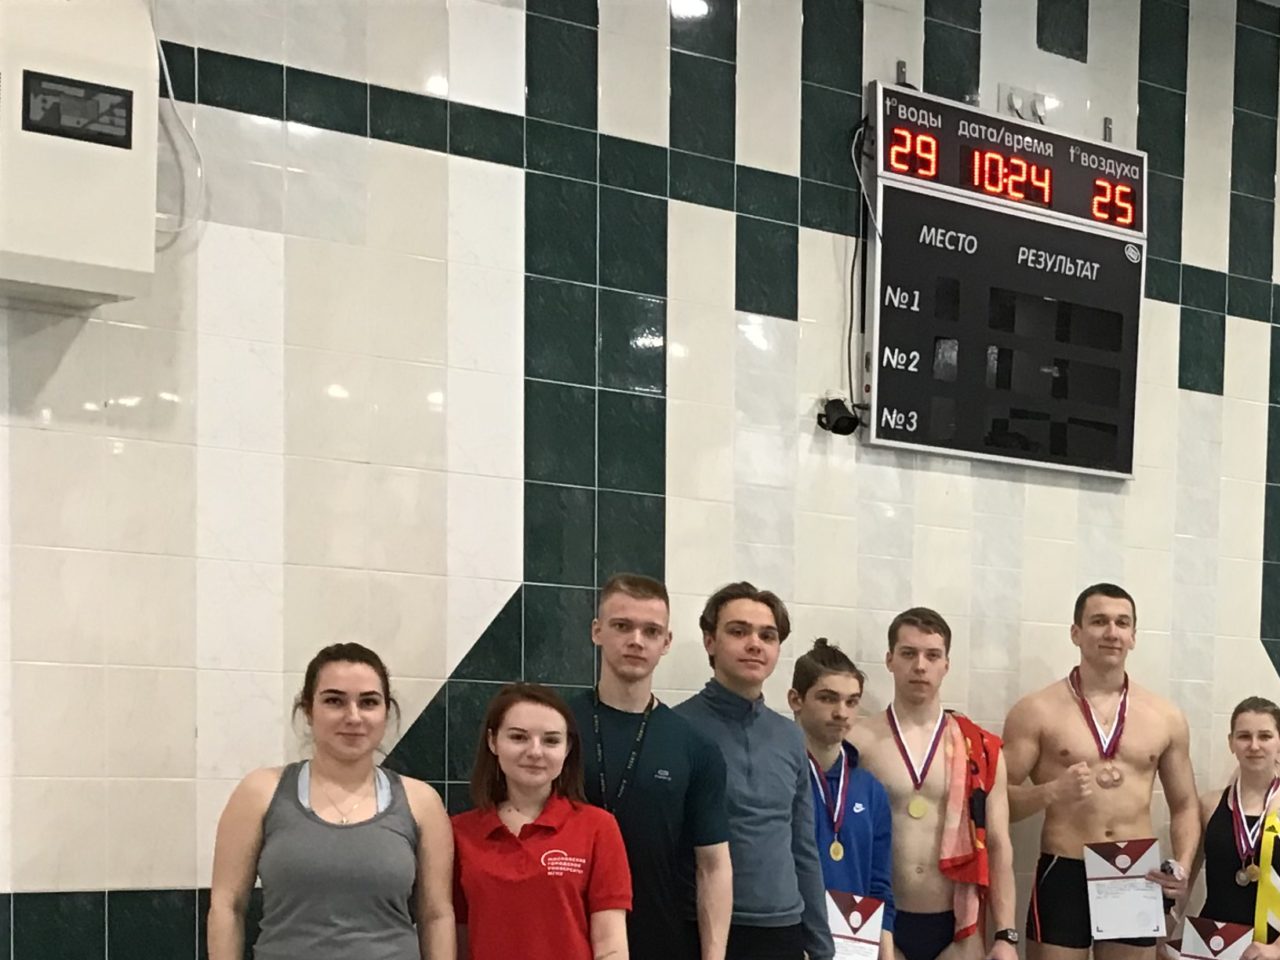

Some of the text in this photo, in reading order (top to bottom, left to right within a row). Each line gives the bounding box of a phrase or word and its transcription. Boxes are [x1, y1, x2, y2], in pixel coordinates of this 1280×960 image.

[890, 127, 936, 176] 29
[958, 120, 1053, 157] дата/время
[973, 151, 1050, 203] 10:24
[1092, 180, 1133, 224] 25
[919, 225, 978, 254] МЕСТО
[1017, 246, 1100, 280] РЕЗУЛЬТАТ
[884, 285, 920, 312] №1
[882, 346, 920, 372] №2
[881, 407, 918, 431] №3
